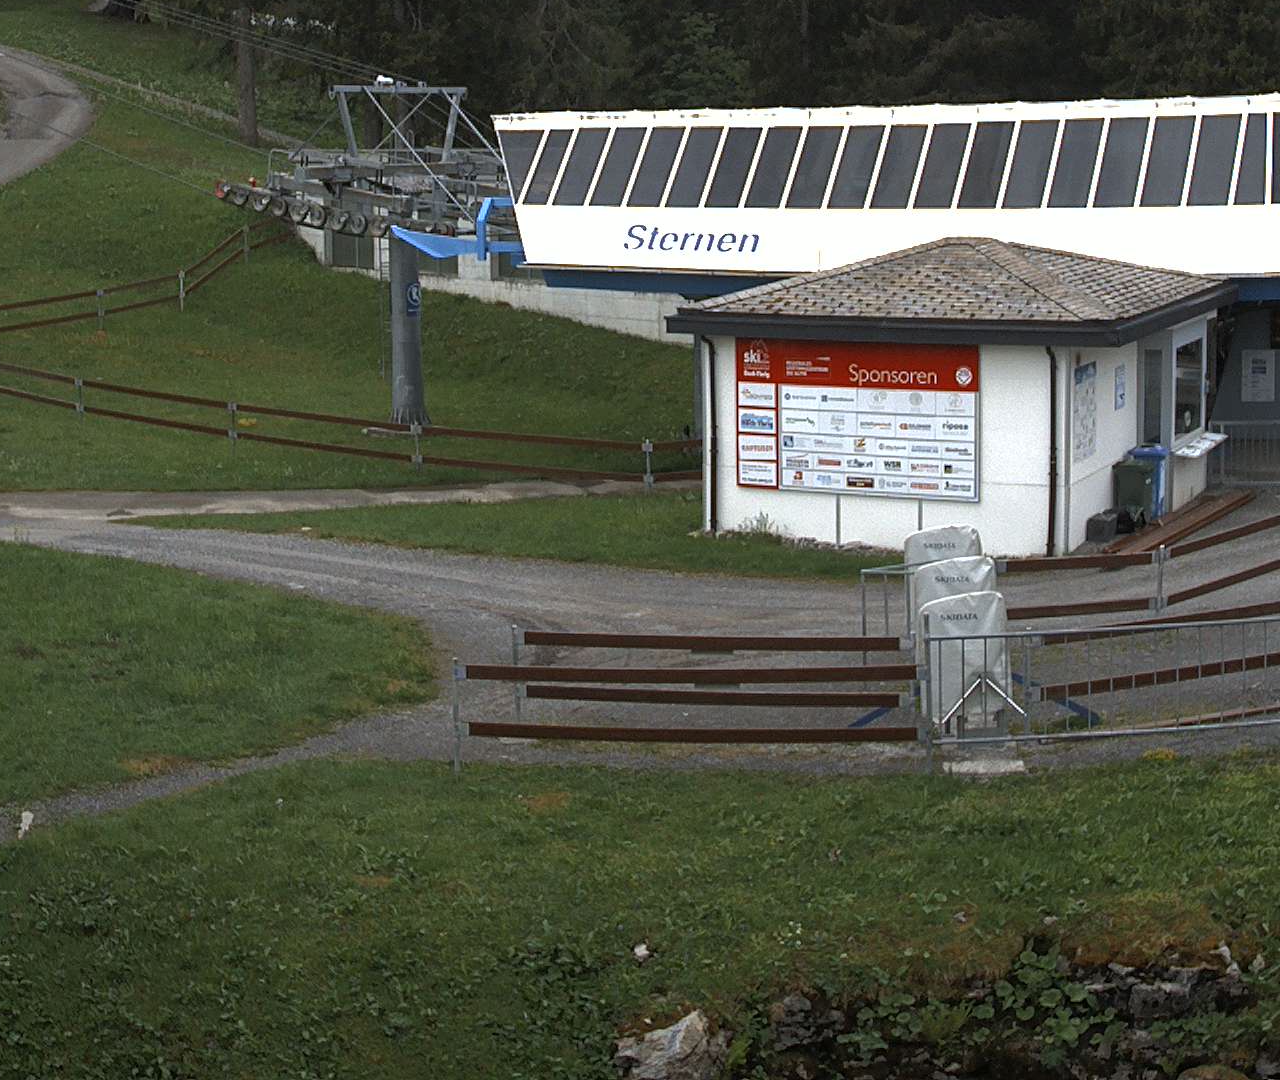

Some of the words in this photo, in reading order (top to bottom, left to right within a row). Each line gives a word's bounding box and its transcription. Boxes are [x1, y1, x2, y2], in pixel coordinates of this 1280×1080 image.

[623, 224, 760, 253] Sternen
[743, 349, 762, 363] ski
[848, 363, 938, 386] Sponsoren
[923, 542, 956, 550] SKIDATA
[935, 575, 970, 583] SKIDATA
[940, 612, 978, 621] SKIDATA
